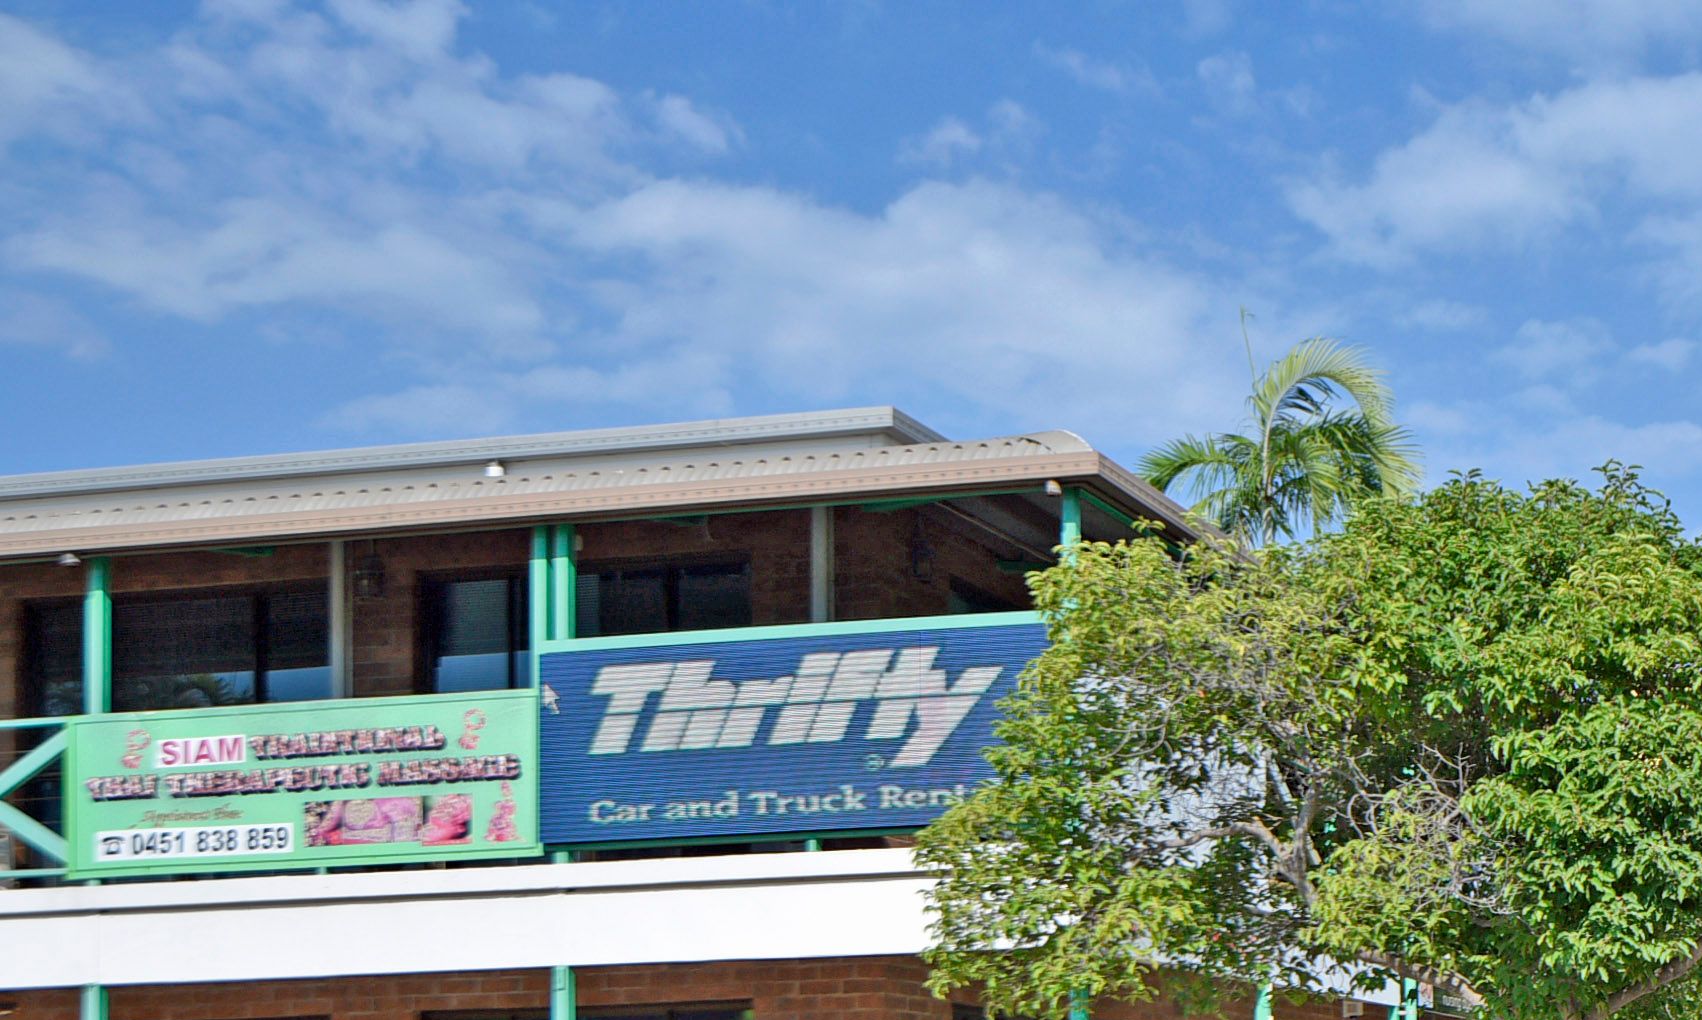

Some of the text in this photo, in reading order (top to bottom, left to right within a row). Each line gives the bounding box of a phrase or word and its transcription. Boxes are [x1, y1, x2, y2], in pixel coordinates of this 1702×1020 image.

[588, 646, 1004, 768] Thrifty
[161, 737, 244, 765] SIAM
[85, 753, 522, 802] THAI THERAPEUTIC MASSAGE
[588, 782, 977, 824] Car and Truck Rent
[132, 826, 289, 855] 0451 838 859
